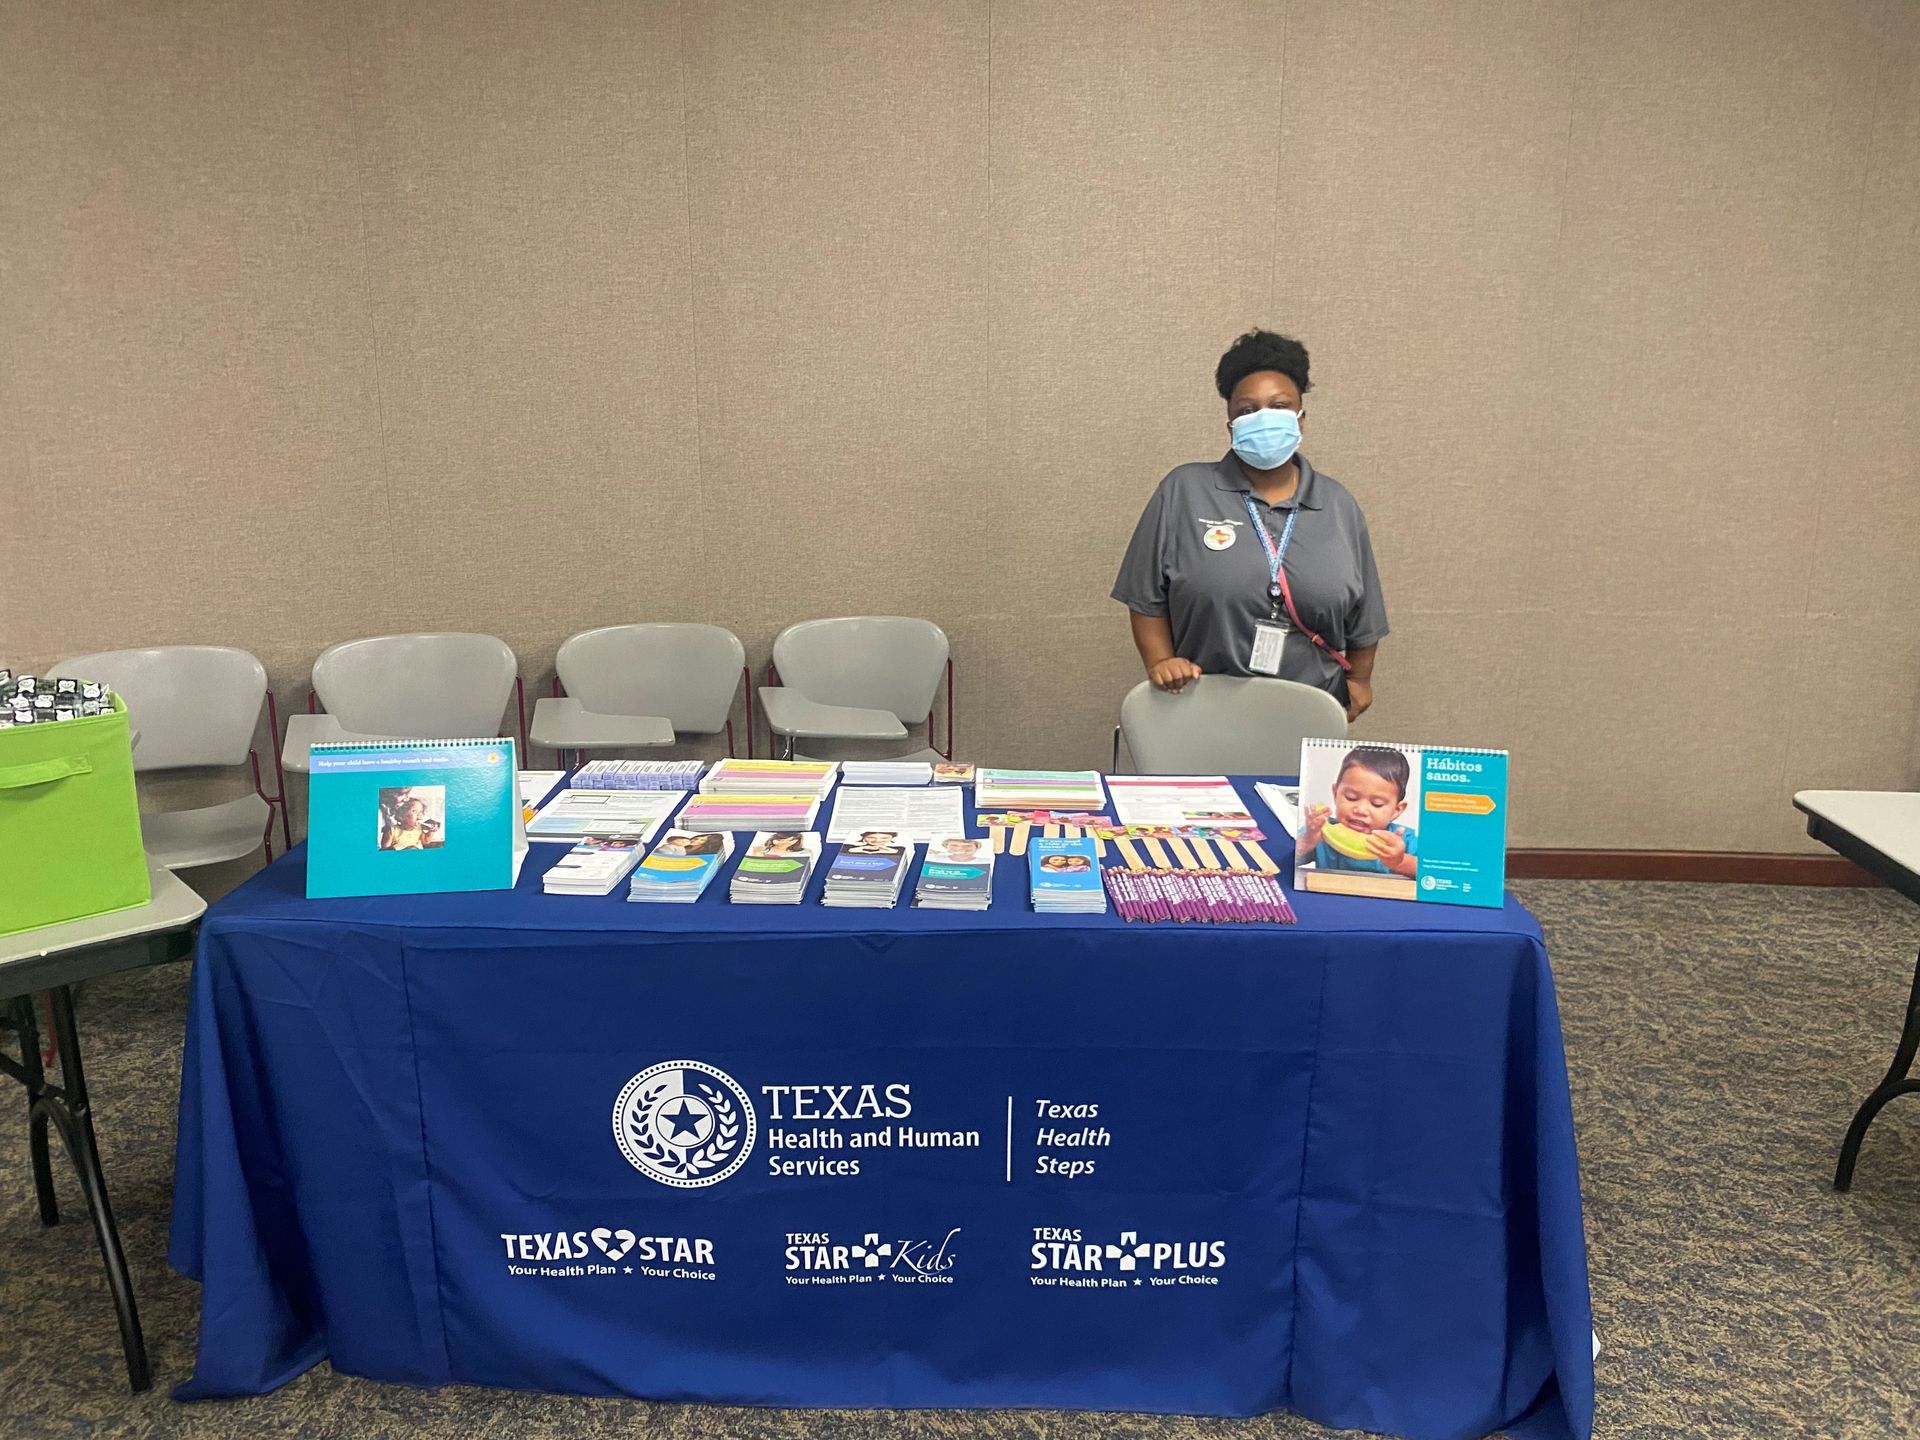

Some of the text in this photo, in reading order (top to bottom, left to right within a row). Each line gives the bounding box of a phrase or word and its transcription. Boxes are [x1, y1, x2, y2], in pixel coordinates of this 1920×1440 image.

[1426, 758, 1482, 773] Hábitos
[1426, 772, 1471, 783] sanos.
[762, 1084, 912, 1120] TEXAS
[1035, 1099, 1099, 1119] Texas
[768, 1126, 980, 1149] Health and Human
[1036, 1127, 1111, 1148] Health
[768, 1155, 860, 1176] Services
[1035, 1155, 1096, 1178] Steps
[785, 1232, 830, 1245] TEXAS
[1032, 1227, 1082, 1242] TEXAS
[501, 1231, 715, 1264] TEXAS STAR
[785, 1227, 961, 1276] STAR Kids
[1030, 1240, 1226, 1271] STAR PLUS
[508, 1264, 716, 1281] Your Health Plan Your Choice
[785, 1273, 954, 1285] Your Health Plan Your Choice
[1030, 1274, 1219, 1288] Your Health Plan Your Choice
